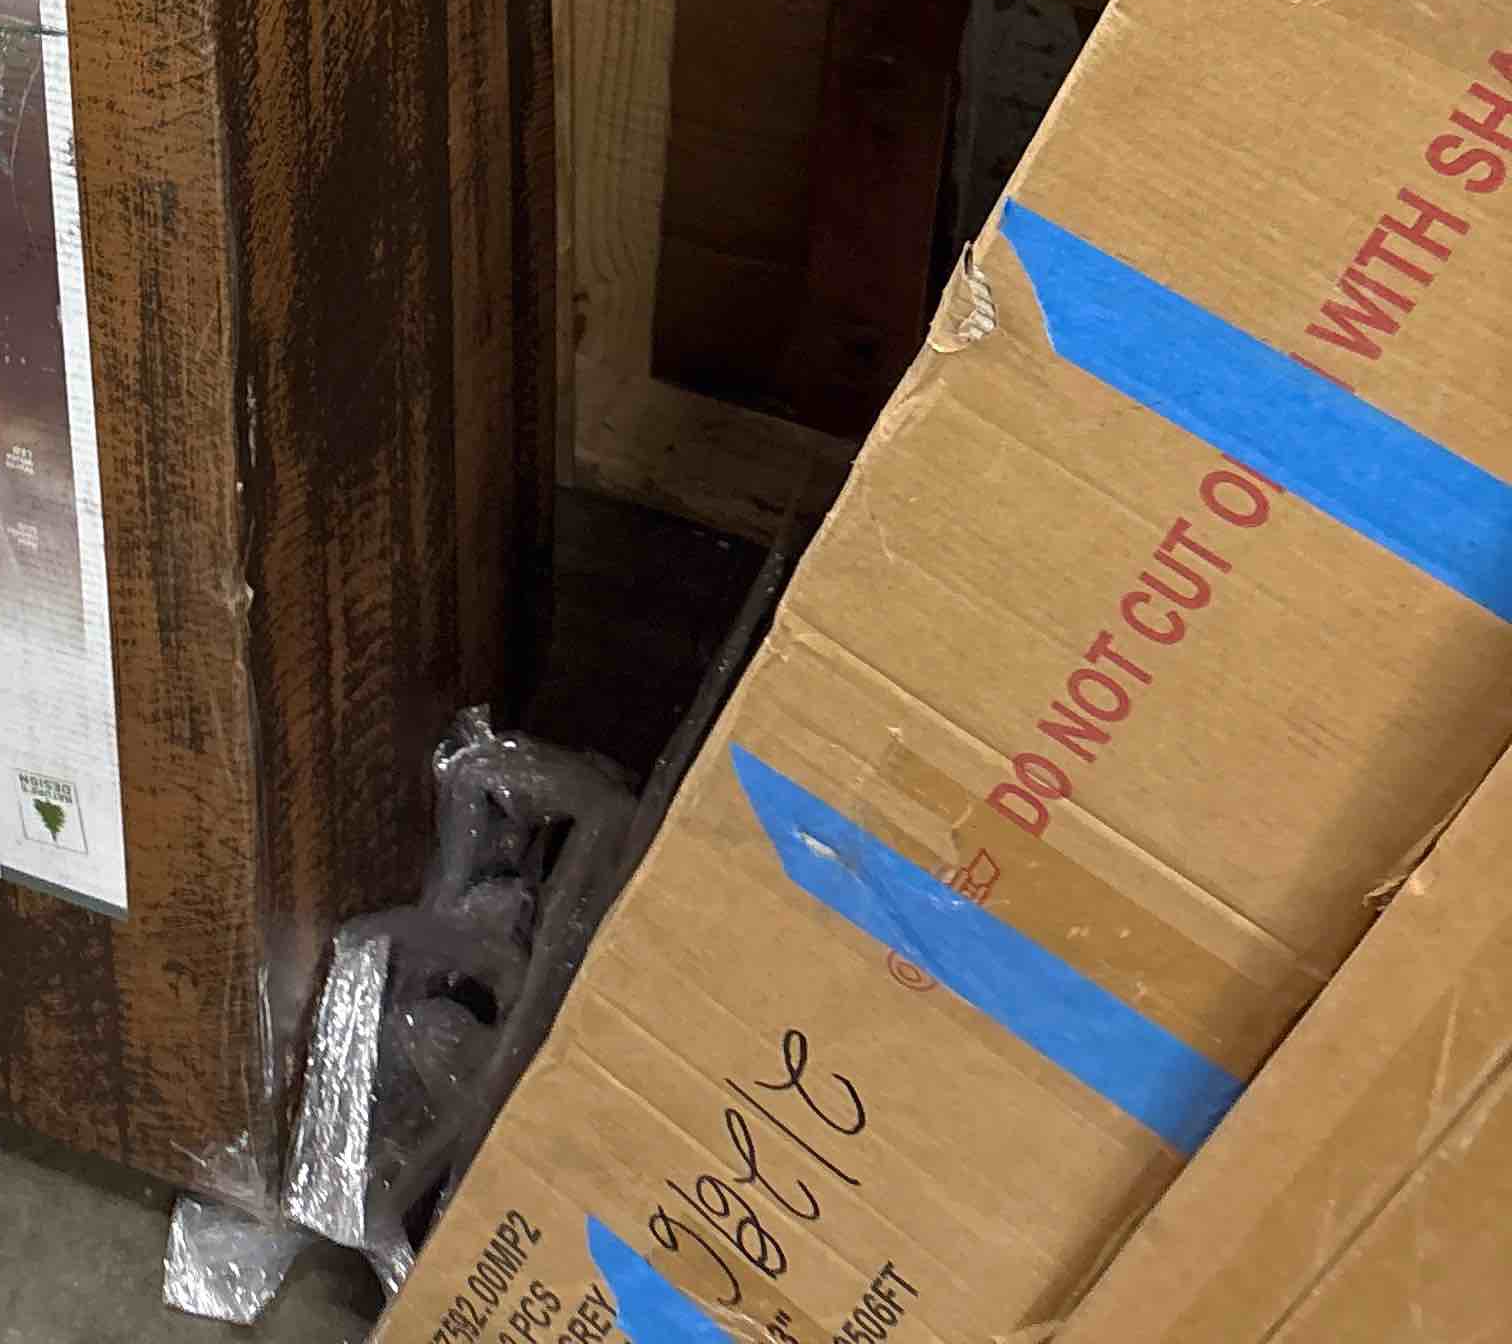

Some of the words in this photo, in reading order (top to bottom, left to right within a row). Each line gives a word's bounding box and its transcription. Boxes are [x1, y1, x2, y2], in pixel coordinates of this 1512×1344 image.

[985, 751, 1072, 839] DO
[1037, 629, 1155, 764] NOT
[1119, 515, 1233, 647] CUT
[1304, 185, 1472, 362] WITH
[18, 772, 72, 796] DESIGN
[511, 1278, 563, 1338] PCS
